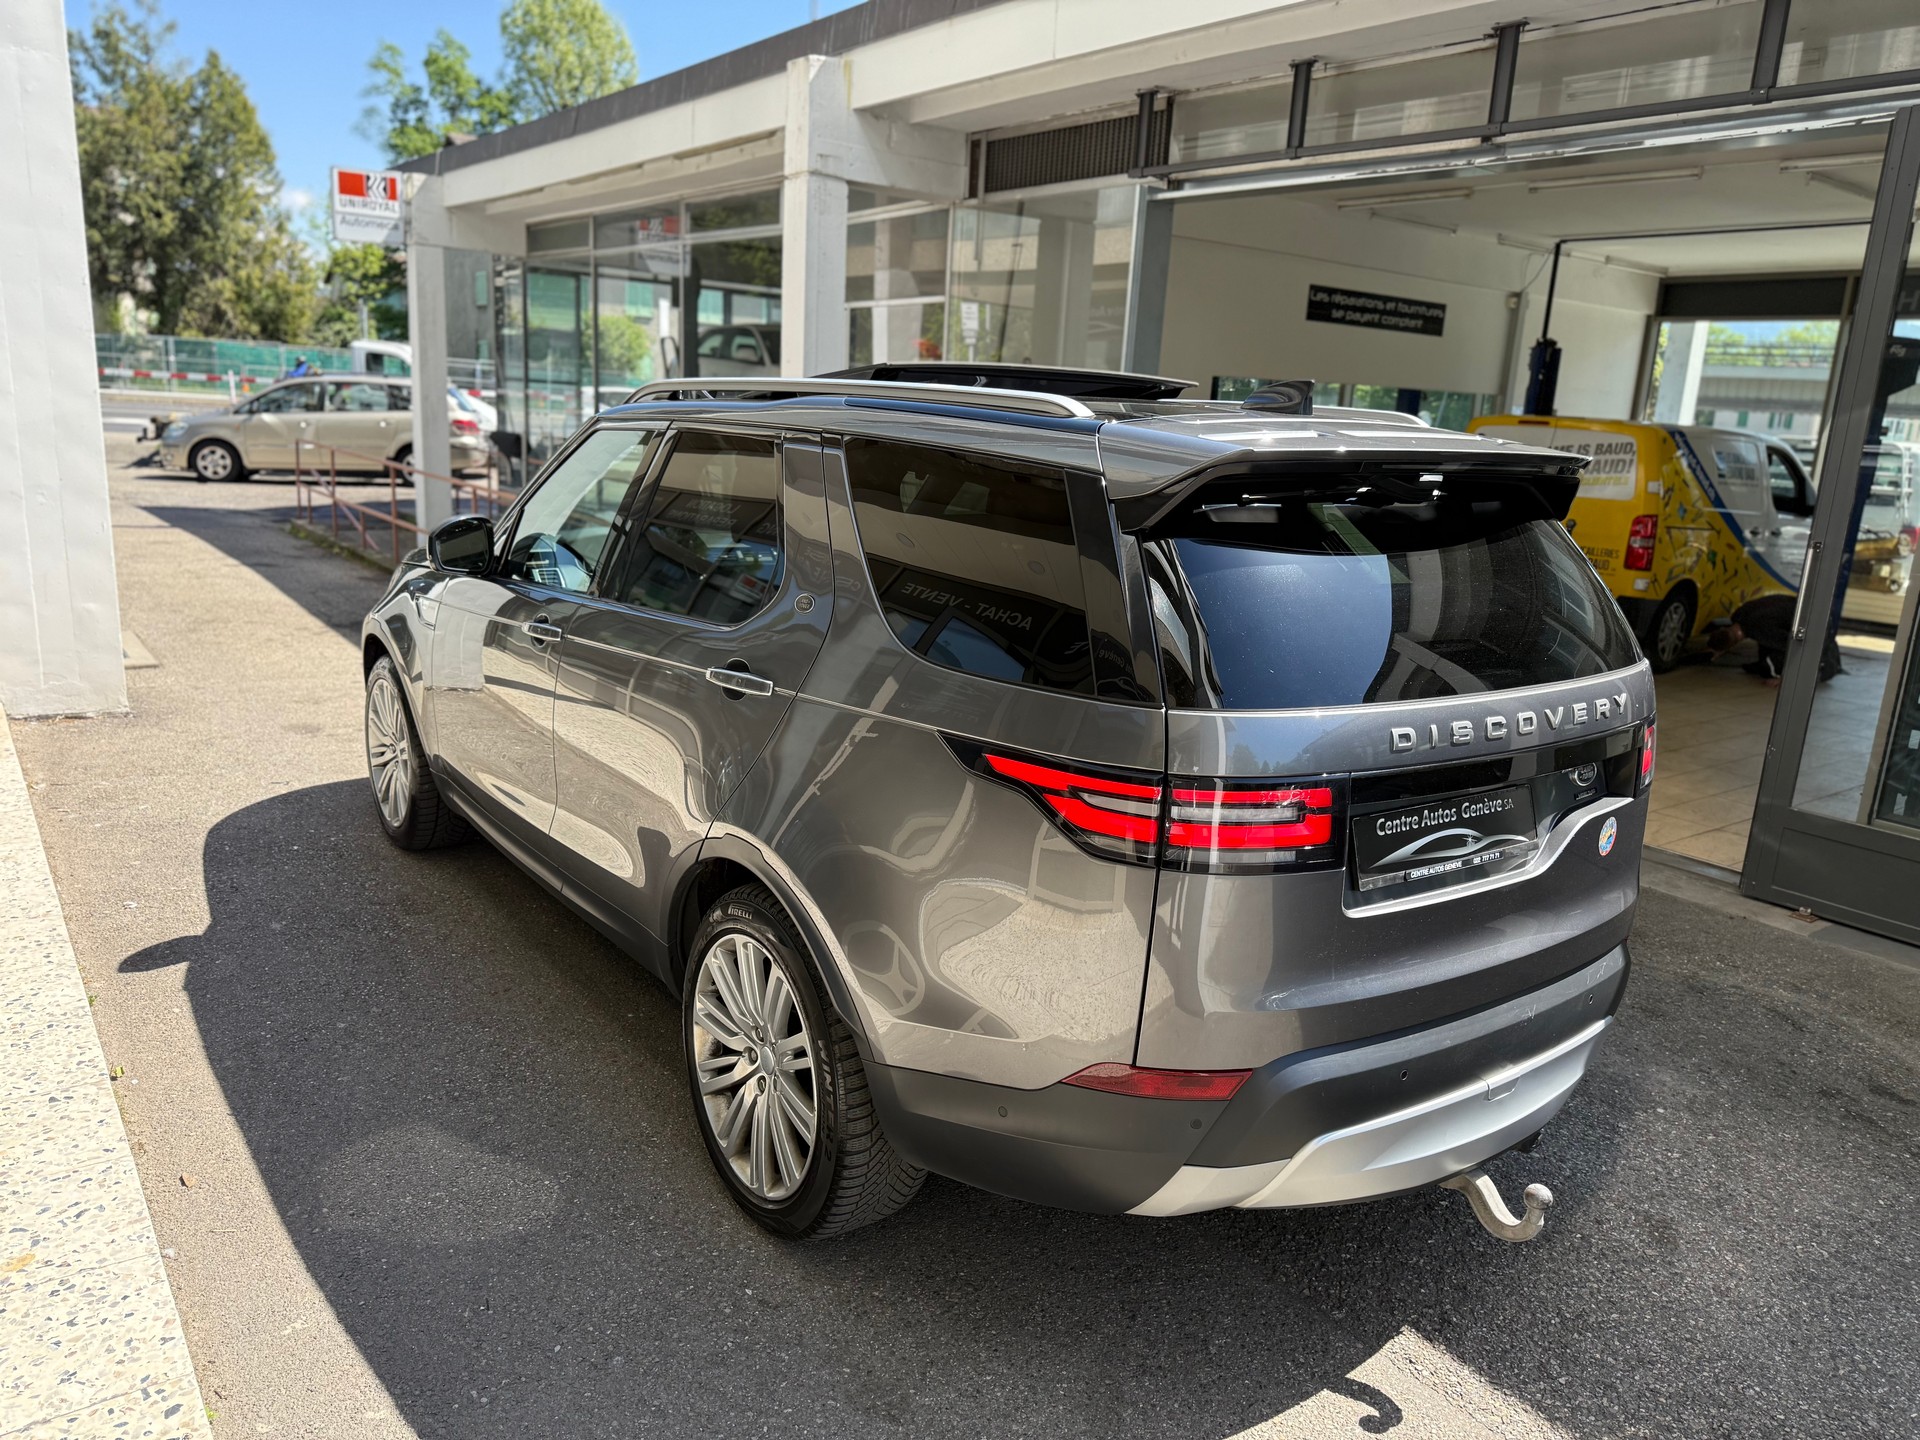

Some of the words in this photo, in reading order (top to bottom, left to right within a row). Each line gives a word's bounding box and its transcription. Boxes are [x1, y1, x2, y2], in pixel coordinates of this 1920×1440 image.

[339, 198, 398, 213] UNIROYAL
[1310, 289, 1329, 303] Les
[1331, 293, 1384, 310] réparations
[1386, 301, 1397, 311] et
[1398, 303, 1443, 318] fournitures
[1331, 309, 1344, 319] se
[1381, 314, 1423, 328] comptant
[1577, 443, 1591, 456] IS
[1594, 441, 1636, 457] BAUD,
[1585, 458, 1634, 475] AUD!
[1390, 692, 1628, 751] DISCOVERY
[1376, 815, 1419, 836] Centre
[1421, 807, 1457, 828] Autos
[1461, 797, 1503, 818] Genève
[1503, 798, 1515, 810] SA
[1410, 868, 1430, 879] CENTRE
[1428, 864, 1445, 875] AUTOS
[727, 903, 754, 920] PIRELLI
[818, 1039, 835, 1143] WINTER
[824, 1145, 832, 1162] 2
